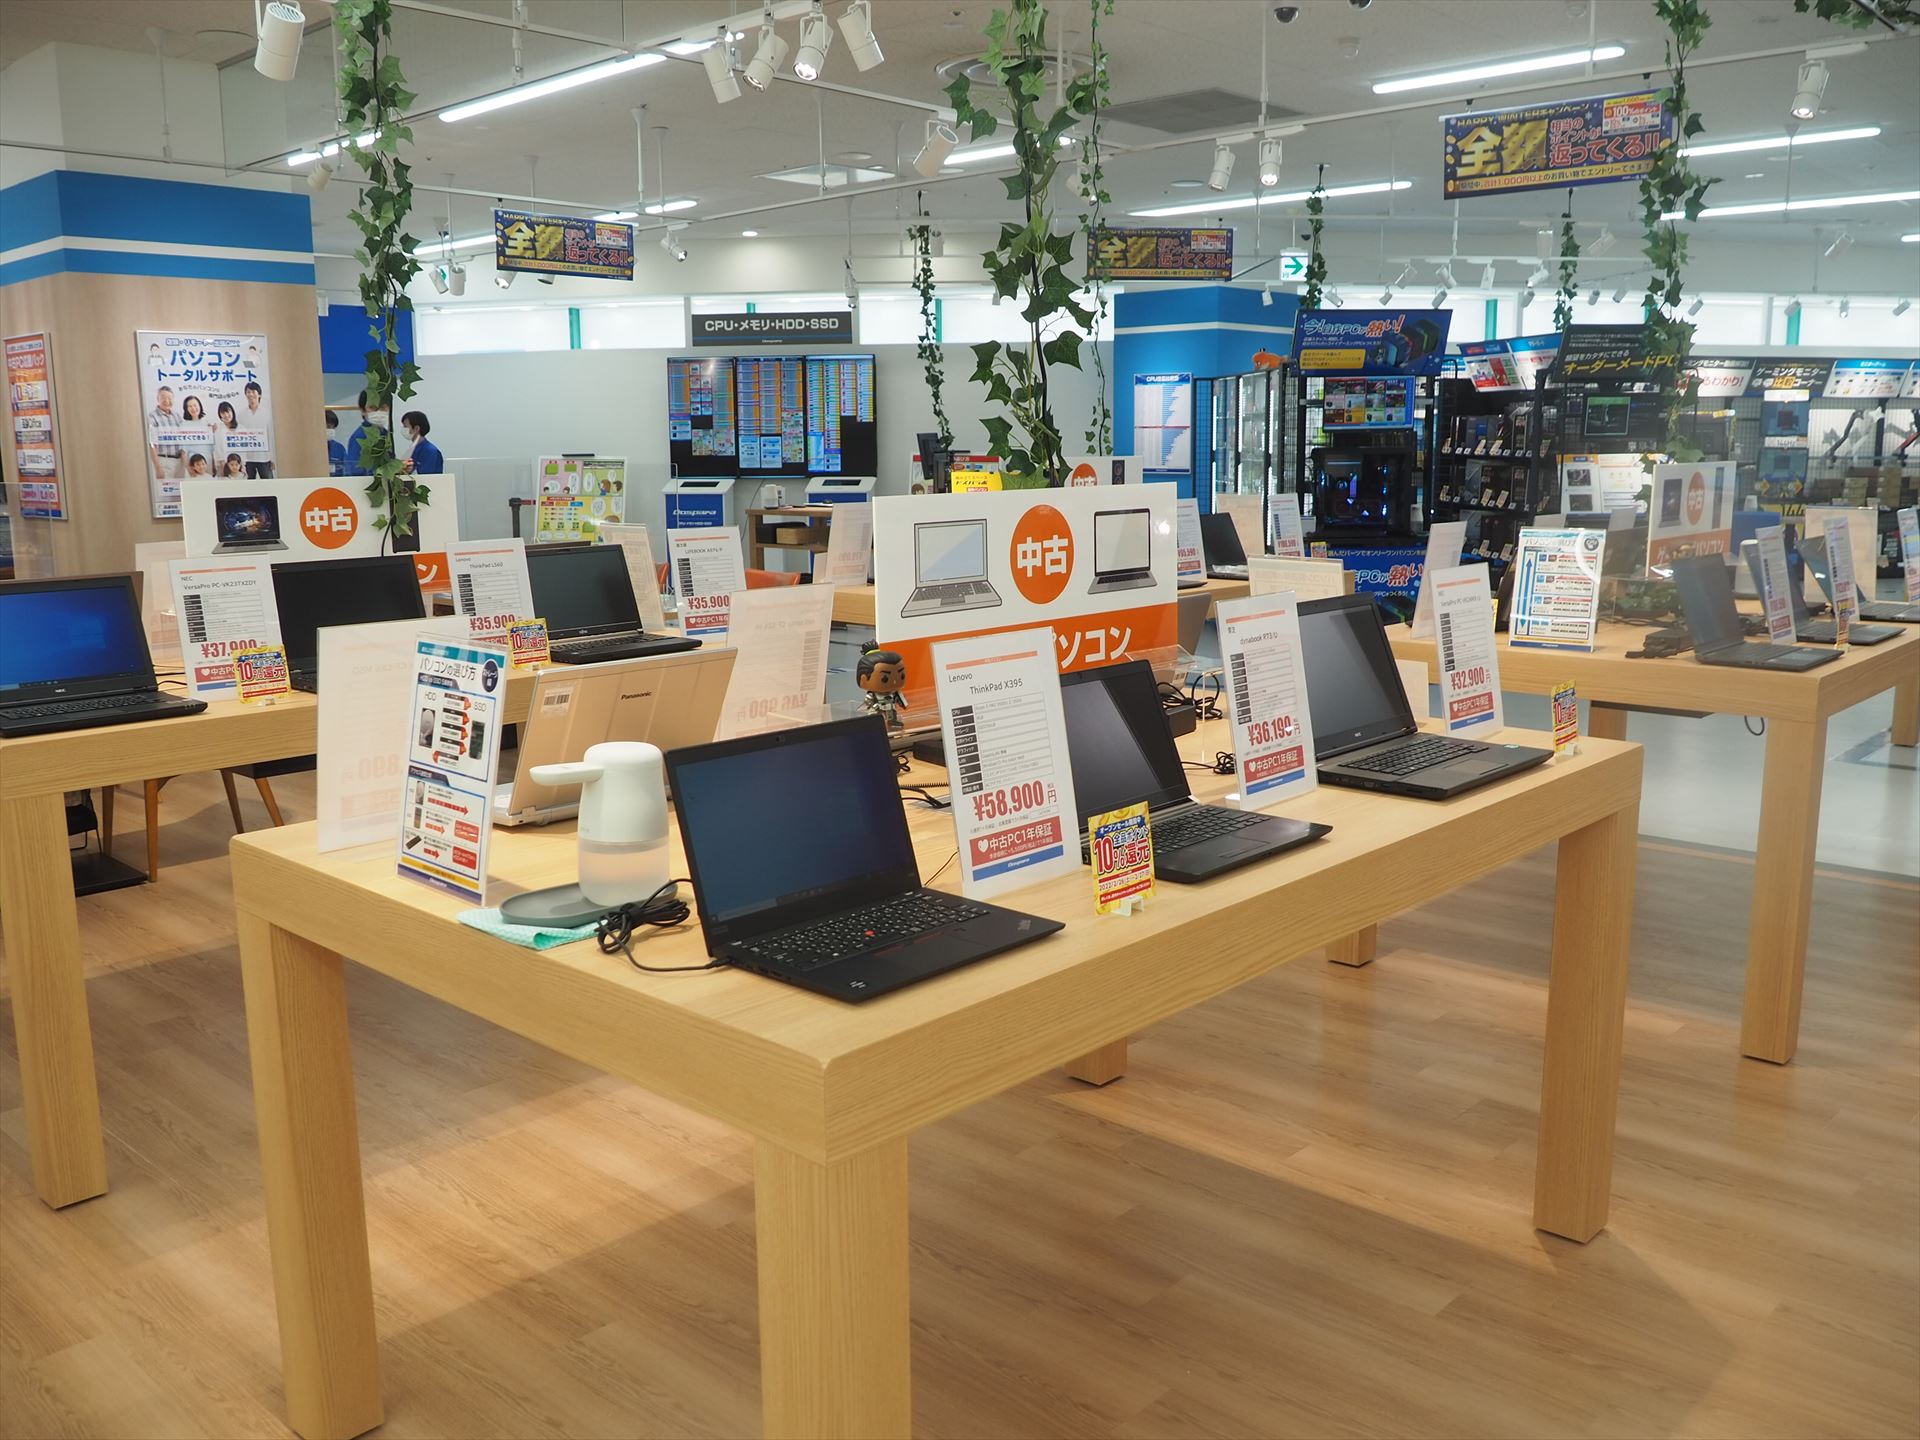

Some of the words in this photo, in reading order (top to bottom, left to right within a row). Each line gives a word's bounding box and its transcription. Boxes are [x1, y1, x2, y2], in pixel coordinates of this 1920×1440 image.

[1550, 127, 1602, 144] ポイントが
[169, 348, 241, 367] パソコン
[157, 367, 258, 382] トータルサポート
[1703, 375, 1745, 388] るわかり!
[305, 506, 353, 534] 中古
[1016, 534, 1069, 578] 中古
[687, 594, 730, 610] ¥35,900
[469, 613, 516, 632] ¥35,900
[696, 614, 729, 624] 中古PC1年保
[1052, 625, 1132, 670] ソコン
[419, 657, 477, 681] パソコンの選び方
[948, 672, 973, 683] Lenovo
[1450, 666, 1485, 691] ¥32,900
[621, 690, 652, 702] Panasonic
[969, 680, 1003, 695] ThinkPad
[1004, 678, 1023, 690] X395
[1256, 749, 1298, 771] 中古PC1年保証
[971, 779, 1045, 822] ¥58,900
[1047, 788, 1057, 804] 円
[988, 821, 1054, 851] 中古PC1年保証
[1093, 836, 1151, 875] 10%還元
